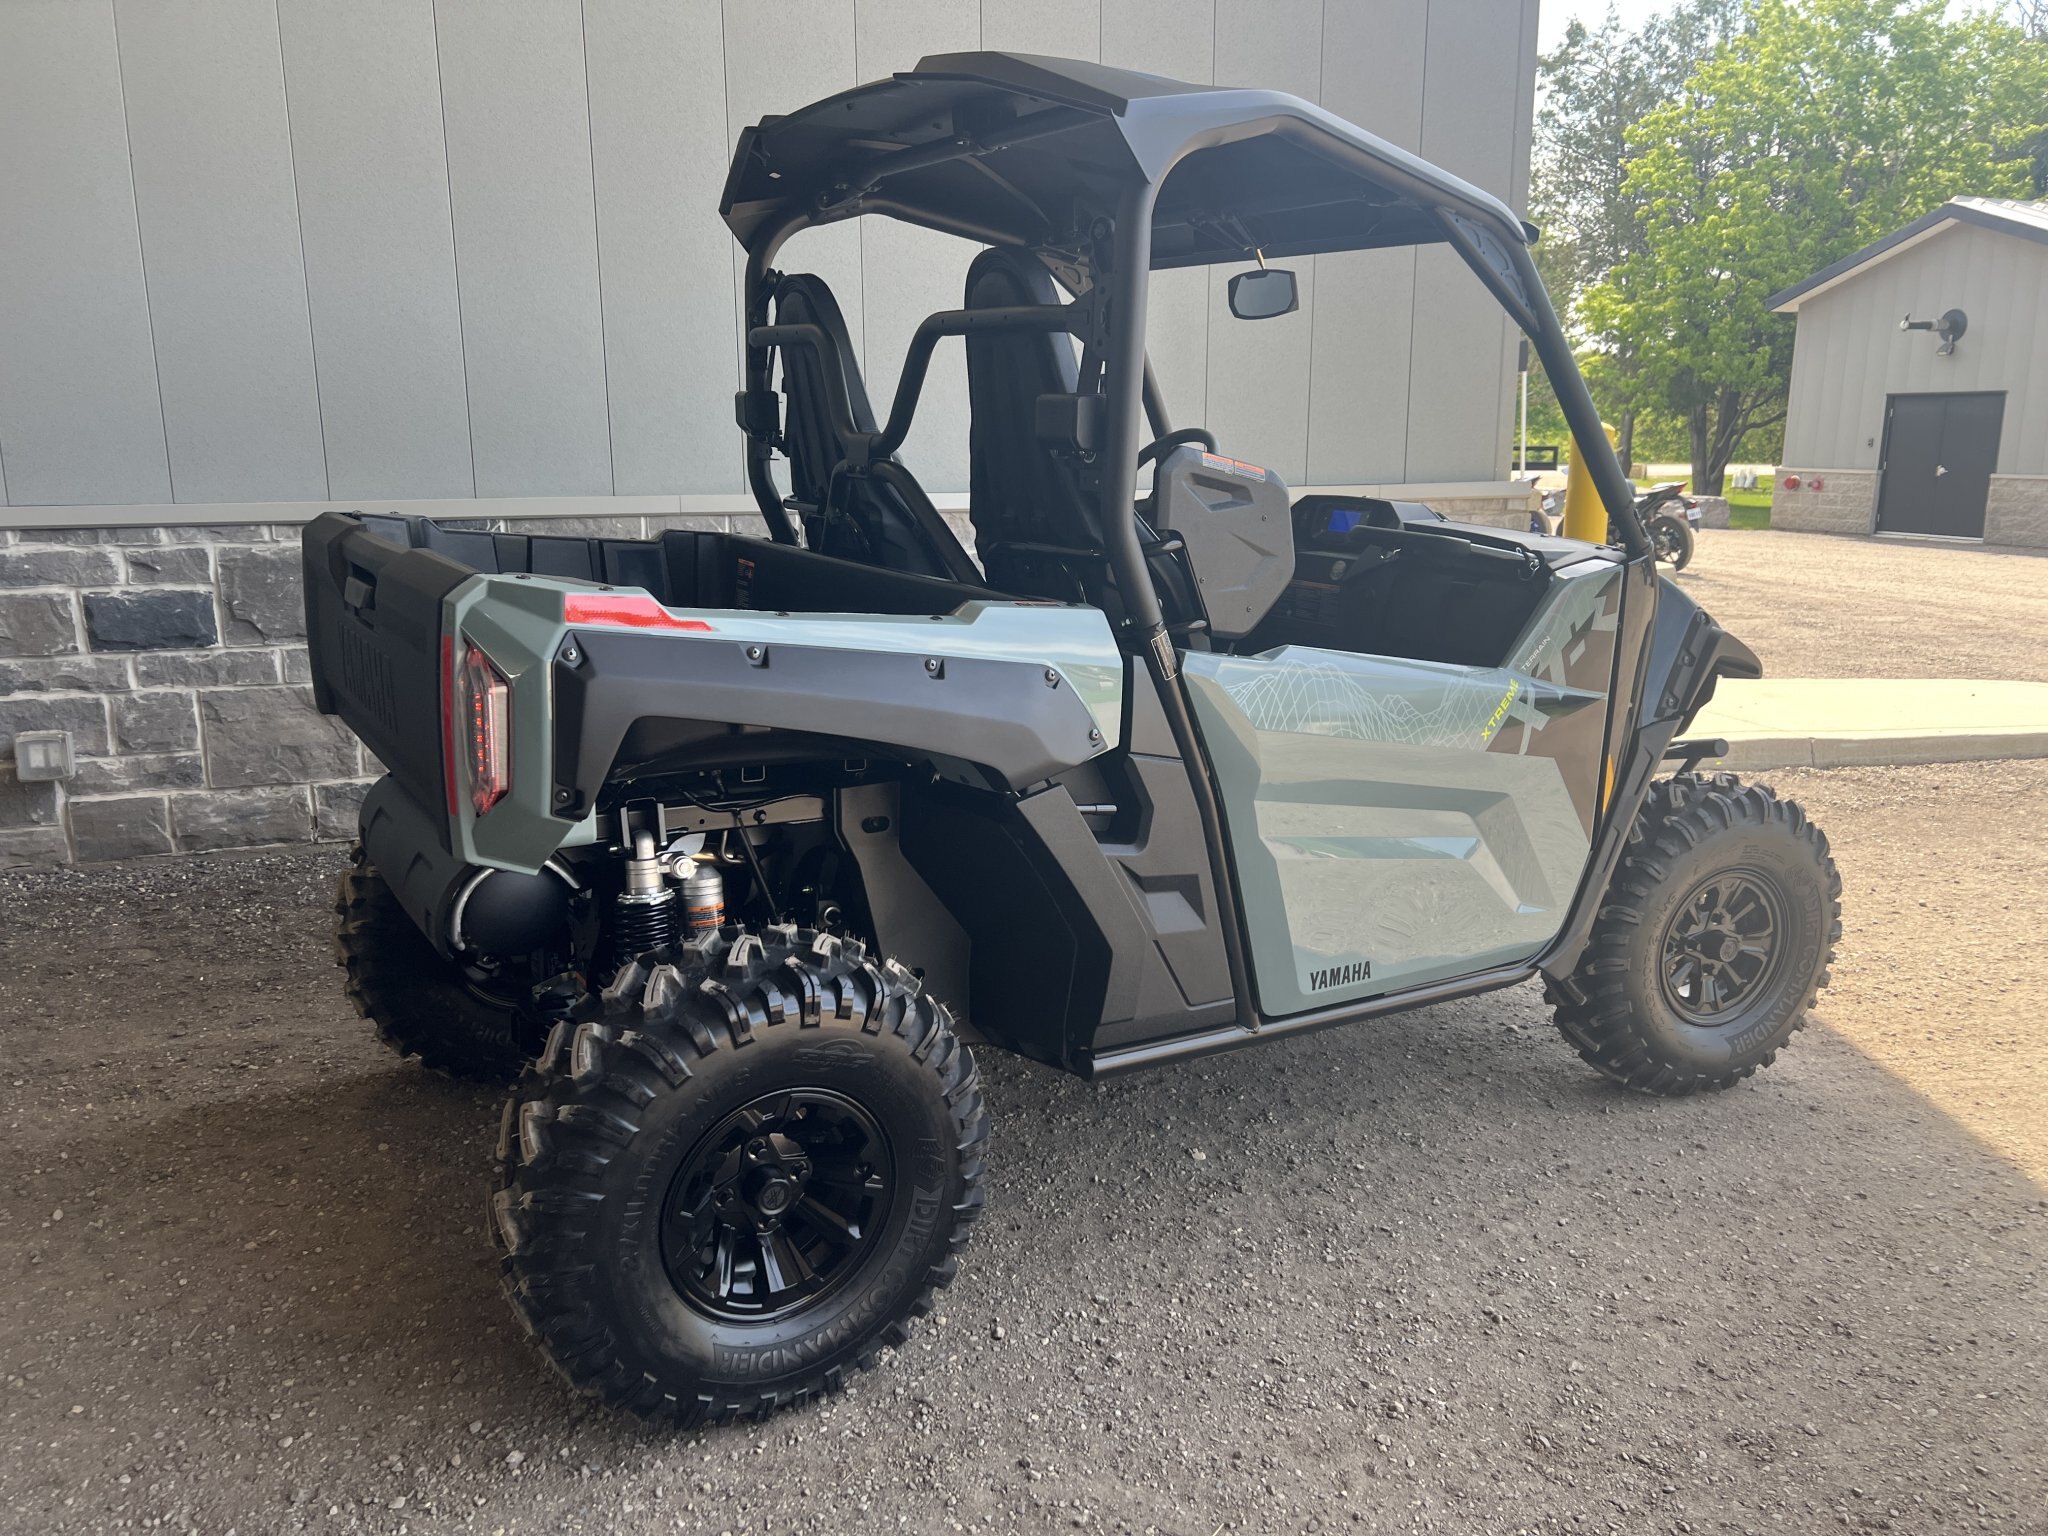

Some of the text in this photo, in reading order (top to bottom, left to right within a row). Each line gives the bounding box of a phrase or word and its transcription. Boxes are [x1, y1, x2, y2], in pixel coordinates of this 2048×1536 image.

[1521, 636, 1550, 671] TERRAIN
[1480, 678, 1519, 742] XTREME
[1310, 961, 1371, 991] YAMAHA
[1733, 893, 1821, 1056] DIRT COMMANDER
[717, 1196, 941, 1378] DIRT COMMANDER
